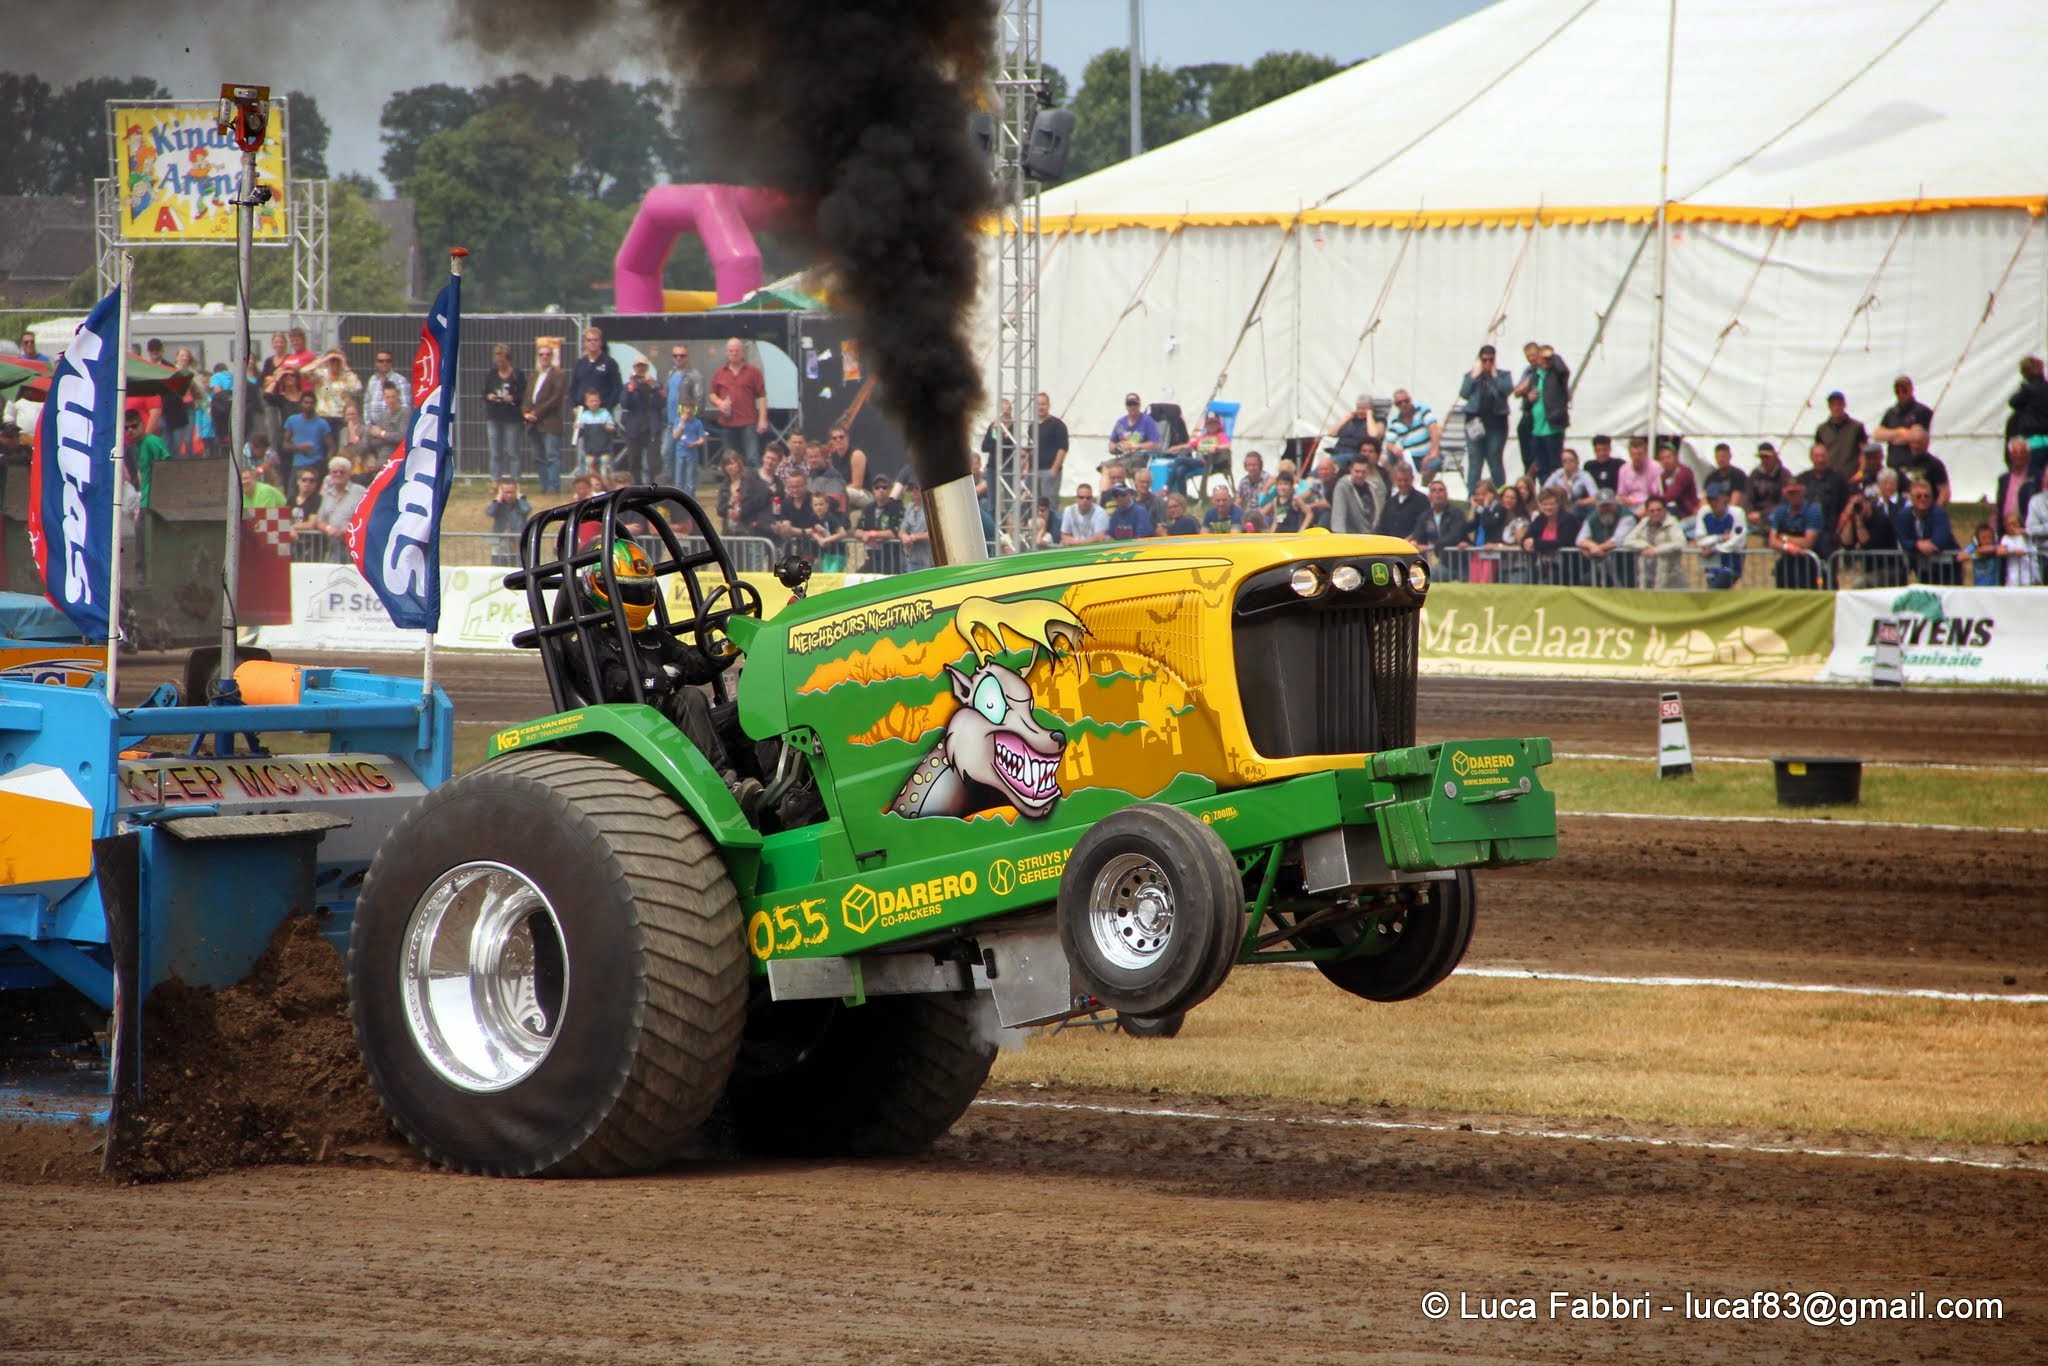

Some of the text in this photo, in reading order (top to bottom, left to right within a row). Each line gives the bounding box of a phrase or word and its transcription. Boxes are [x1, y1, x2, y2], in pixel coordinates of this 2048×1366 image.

[57, 324, 103, 605] Mitas
[329, 592, 383, 612] P.Sto
[793, 600, 933, 654] NEIGHBOURS NIGHTMARE
[1419, 606, 1636, 660] Makelaars
[1662, 703, 1679, 716] 50
[520, 724, 540, 735] KEES
[541, 720, 557, 729] VAN
[558, 713, 584, 725] BEECK
[541, 722, 580, 737] TRANSPORT
[1469, 754, 1514, 769] DARERO
[118, 761, 395, 801] KEEP MOVING
[1463, 777, 1510, 786] WWW.DARERO.NL
[1017, 848, 1073, 871] STRUYS M
[878, 870, 978, 916] DARERO
[881, 904, 942, 928] CO-PACKERS
[749, 897, 830, 960] 055
